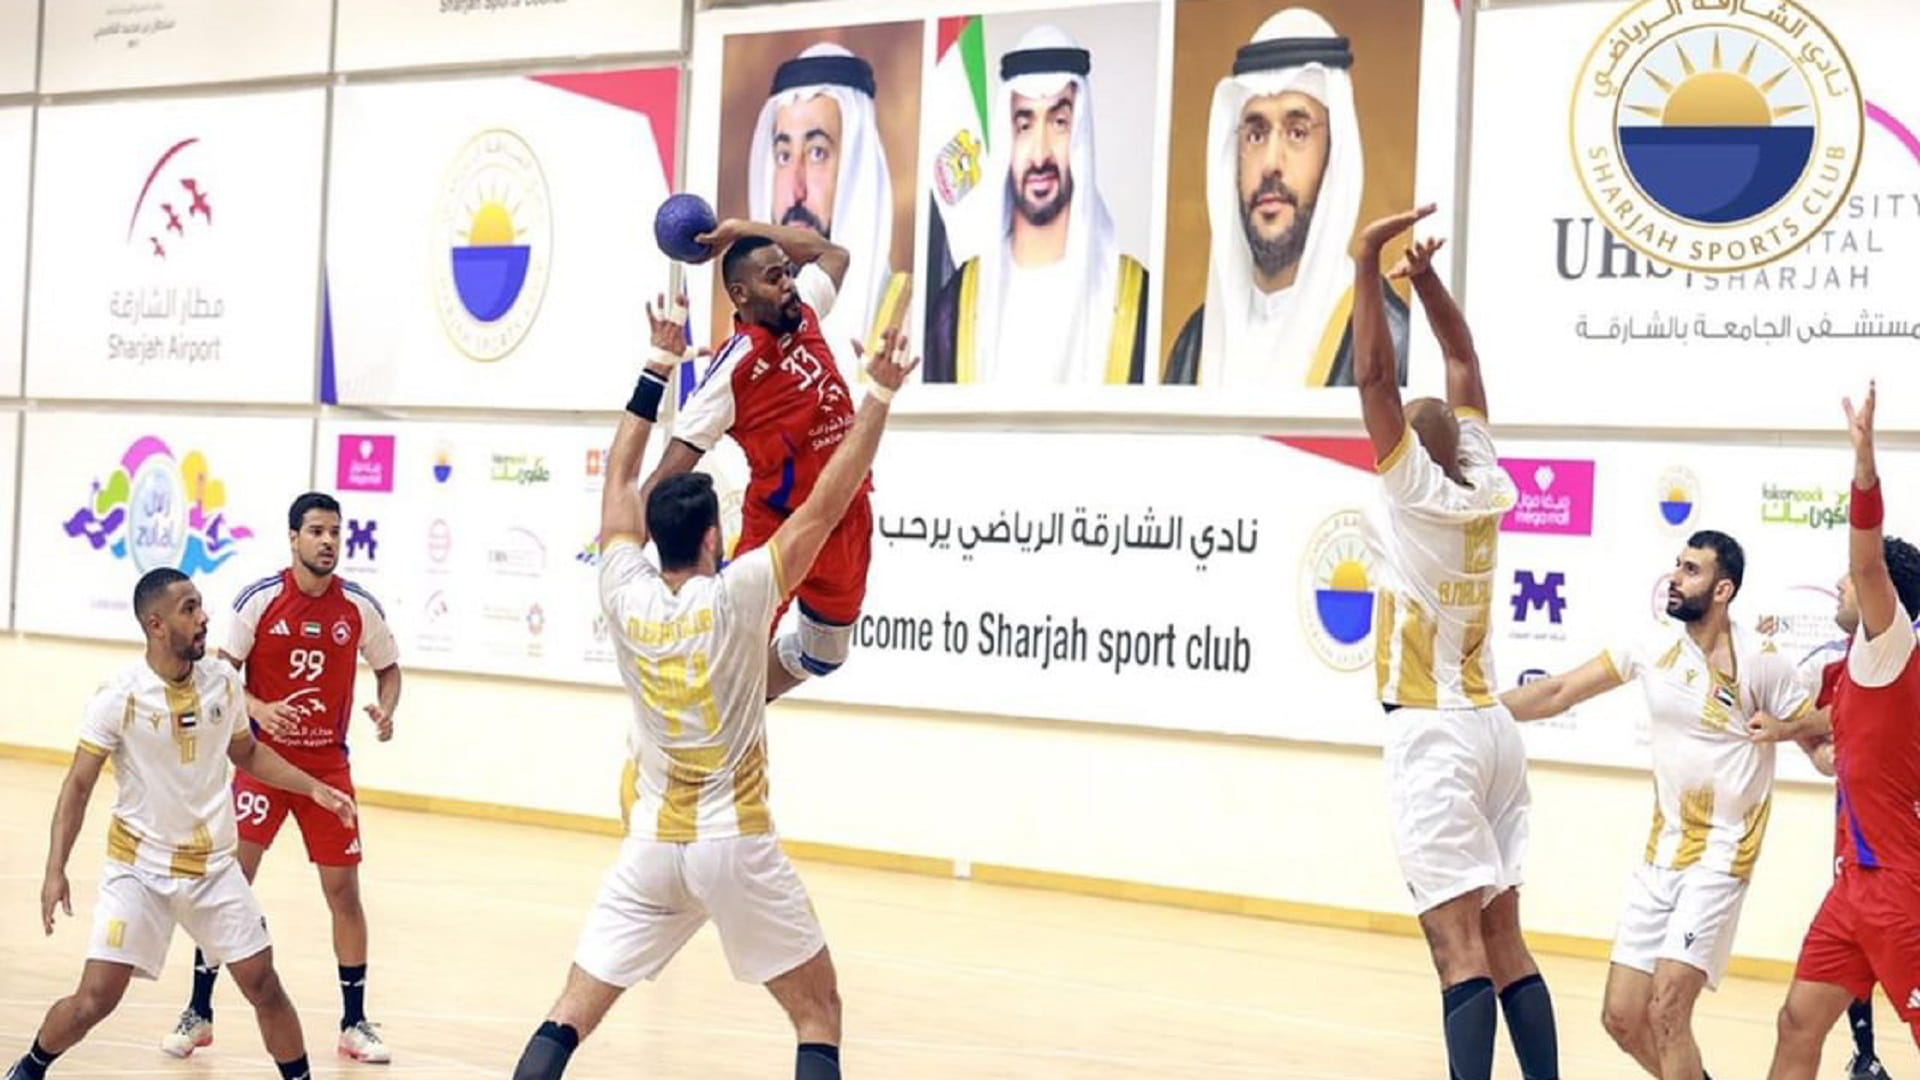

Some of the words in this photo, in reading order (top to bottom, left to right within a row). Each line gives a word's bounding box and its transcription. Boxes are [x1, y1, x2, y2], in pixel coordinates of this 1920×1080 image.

[1704, 264, 1869, 291] SHARJAH
[780, 344, 823, 392] 33
[878, 514, 951, 550] يرحب
[957, 510, 1065, 562] الرياضي
[1071, 505, 1183, 556] الشارقة
[1190, 518, 1258, 572] نادي
[288, 649, 326, 682] 99
[943, 610, 969, 654] to
[978, 612, 1088, 670] Sharjah
[1098, 623, 1176, 675] sport
[1185, 624, 1251, 673] club
[235, 791, 270, 826] 99
